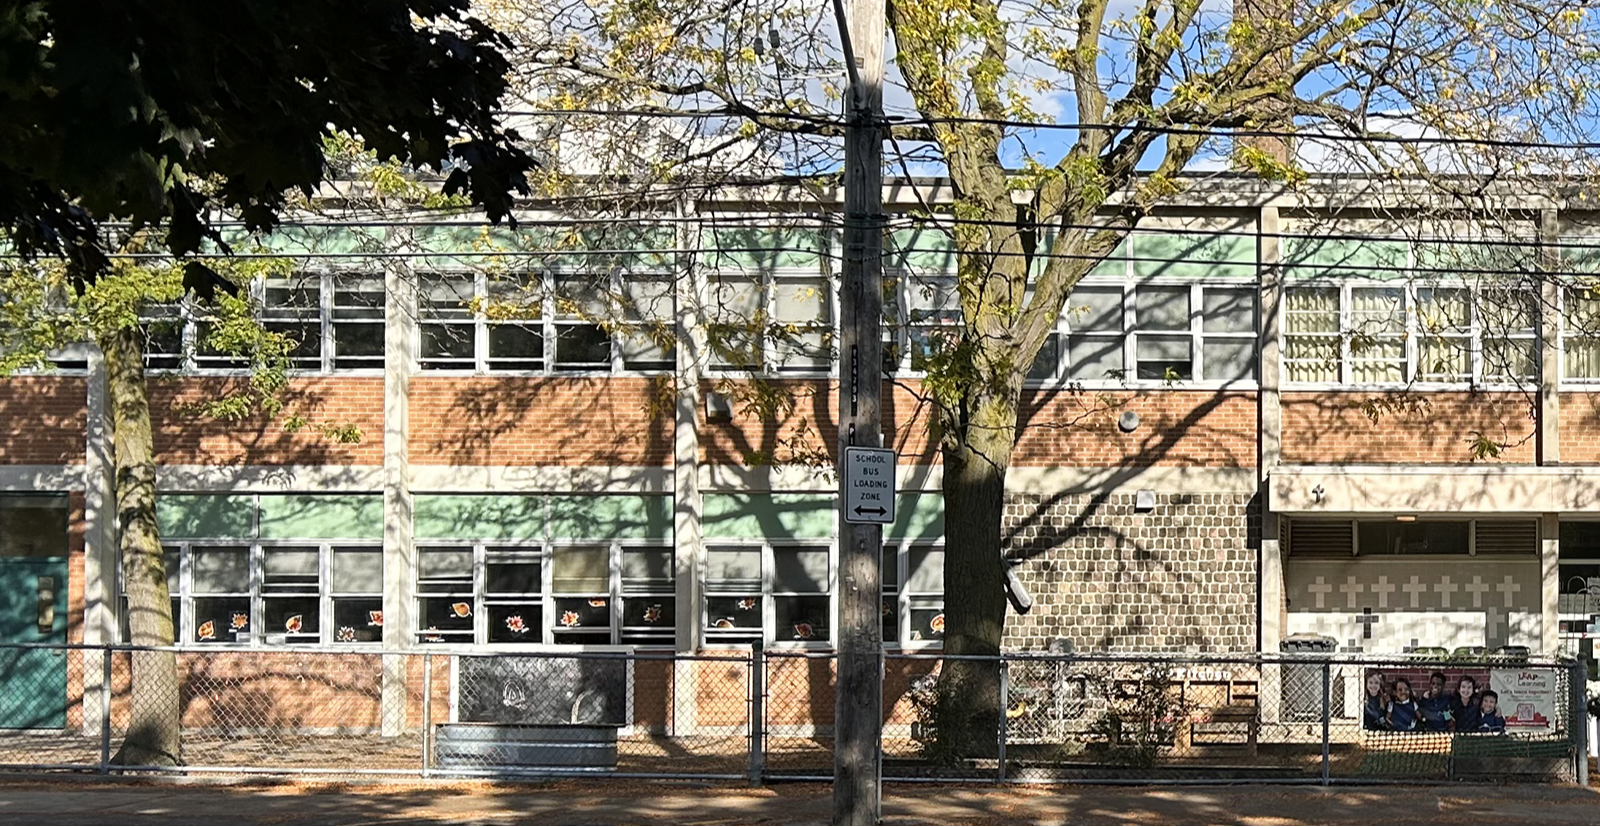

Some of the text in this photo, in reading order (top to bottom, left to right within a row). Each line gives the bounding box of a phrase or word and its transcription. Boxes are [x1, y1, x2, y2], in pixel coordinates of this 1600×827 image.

[856, 455, 886, 463] SCHOOL
[863, 467, 879, 475] BUS
[854, 480, 887, 488] LOADING
[861, 493, 881, 501] ZONE
